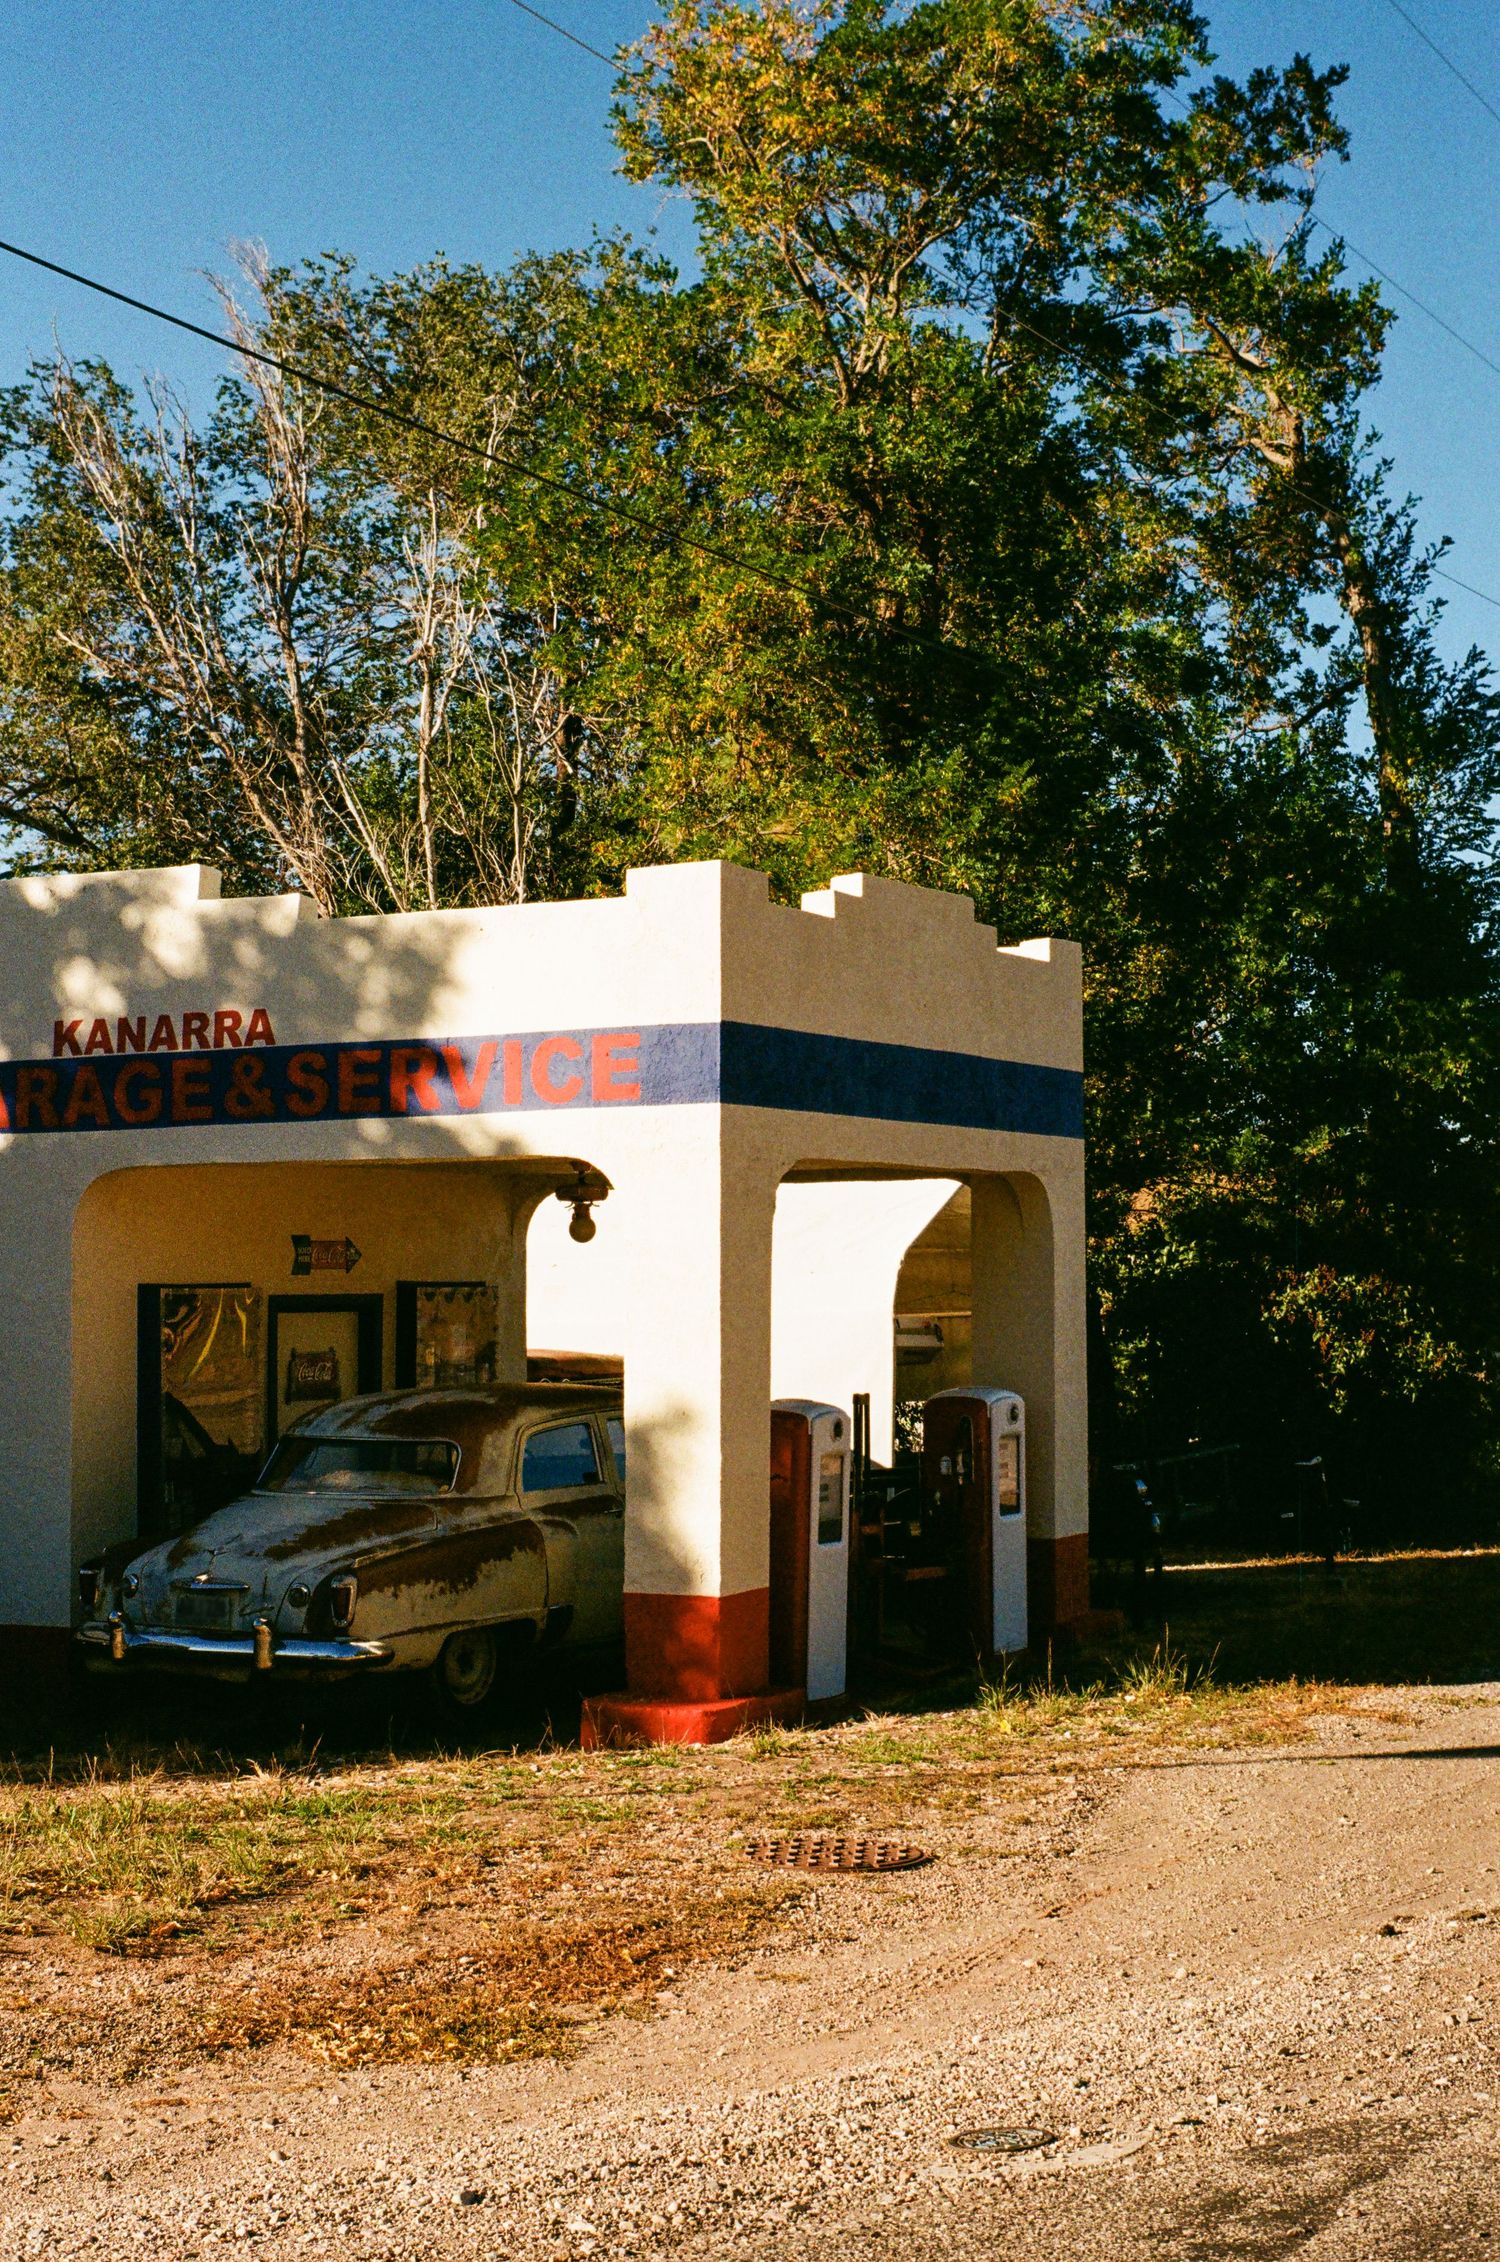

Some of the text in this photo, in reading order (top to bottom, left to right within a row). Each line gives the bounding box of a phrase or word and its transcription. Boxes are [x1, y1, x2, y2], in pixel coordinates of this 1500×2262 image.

[53, 1008, 276, 1057] KANARRA
[0, 1033, 643, 1130] RAGE & SERVICE
